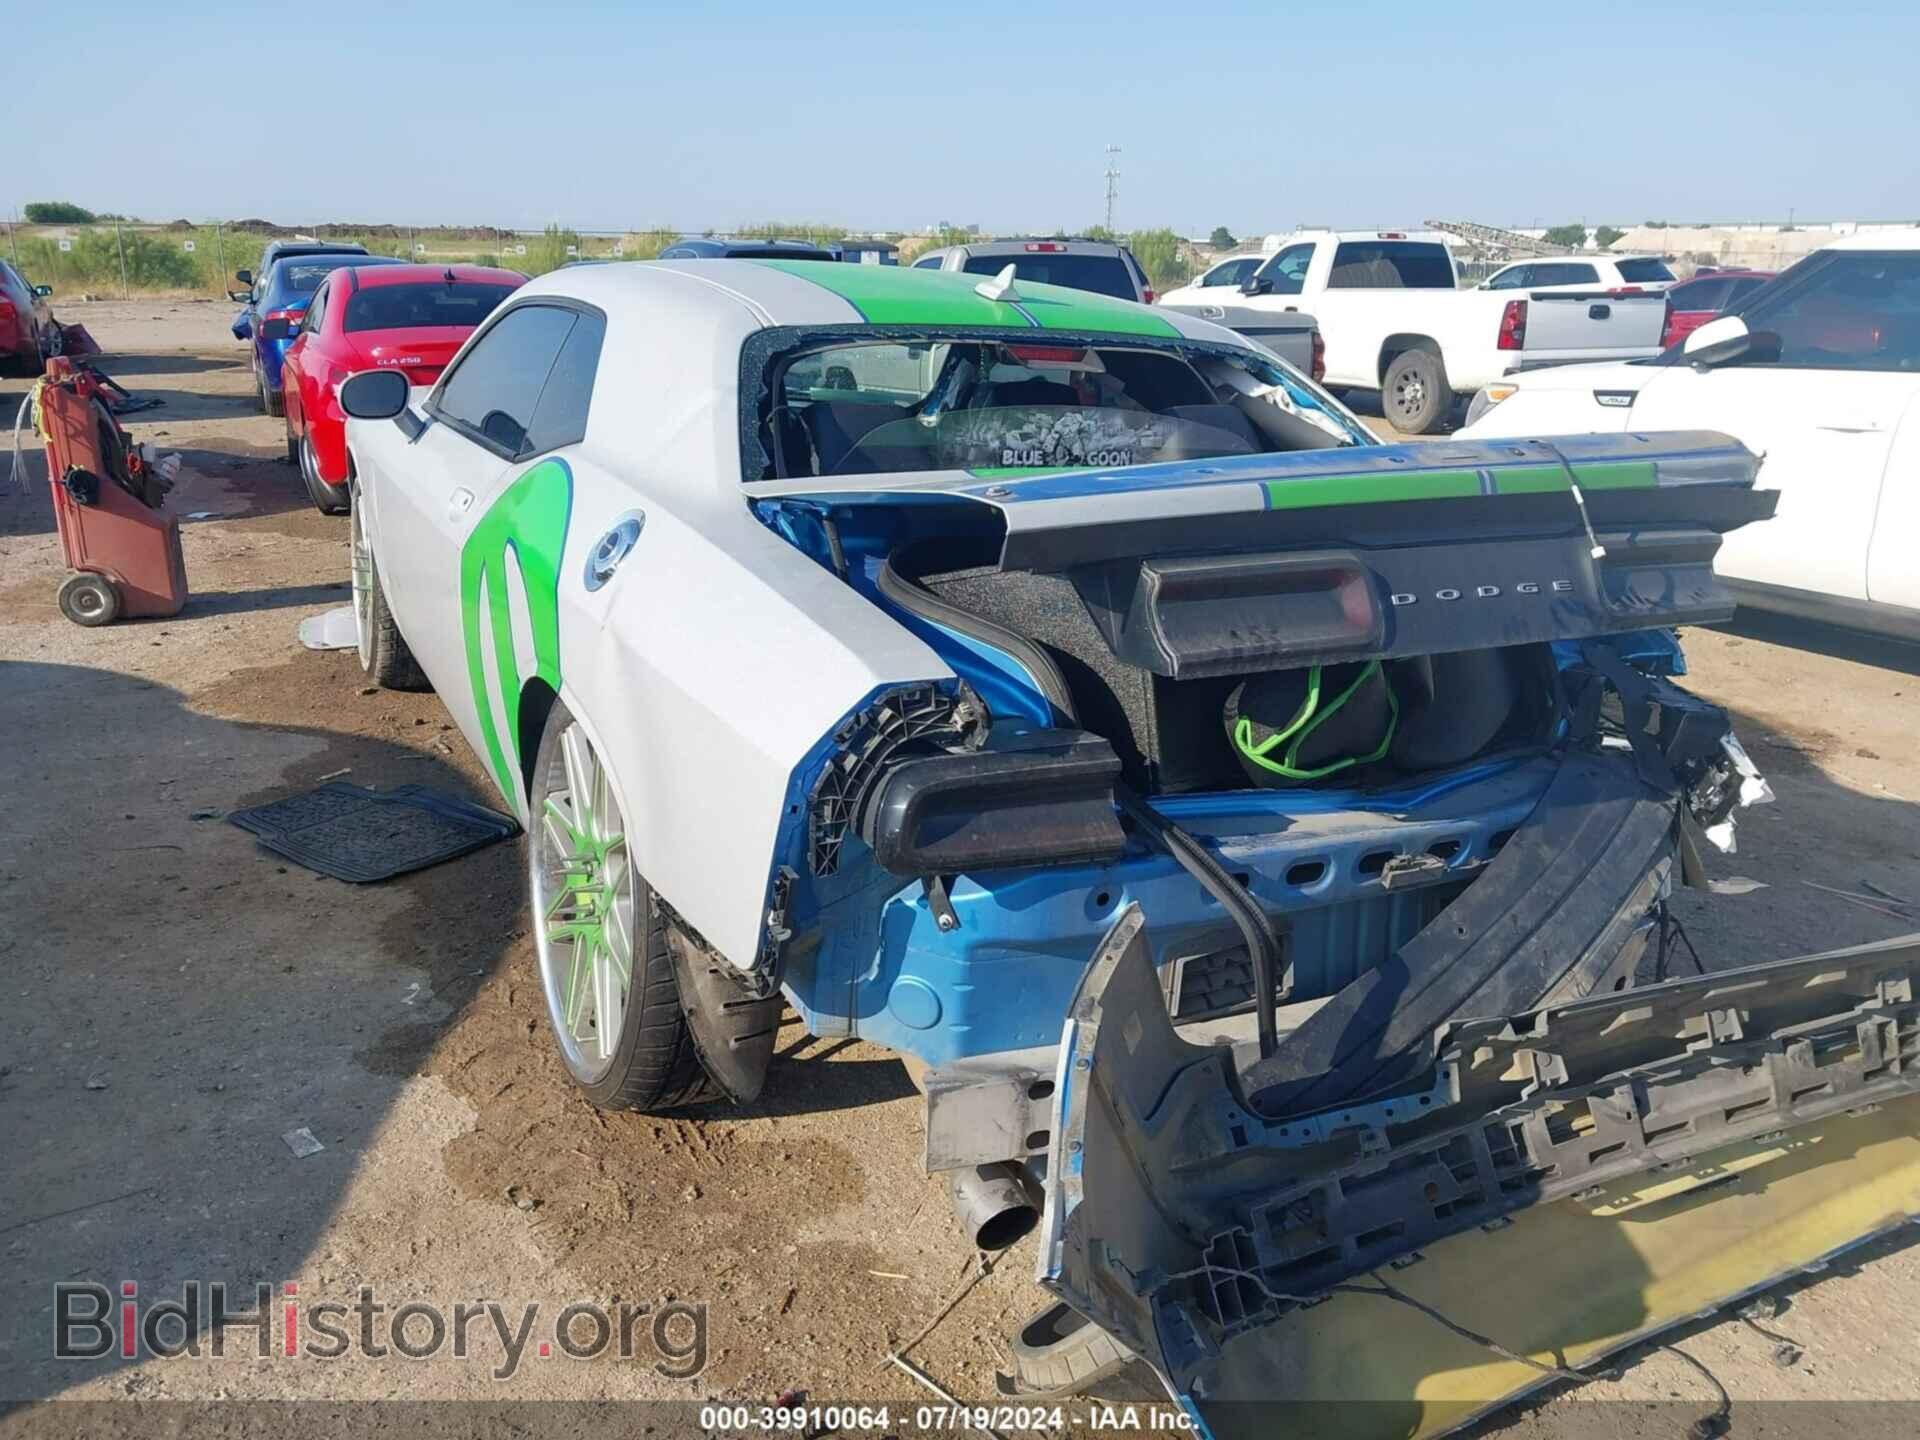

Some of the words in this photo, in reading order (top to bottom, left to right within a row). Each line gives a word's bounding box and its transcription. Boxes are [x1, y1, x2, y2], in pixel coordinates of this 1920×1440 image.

[376, 358, 398, 367] CLA
[1001, 449, 1044, 466] BLUE
[1390, 579, 1574, 606] DODGE
